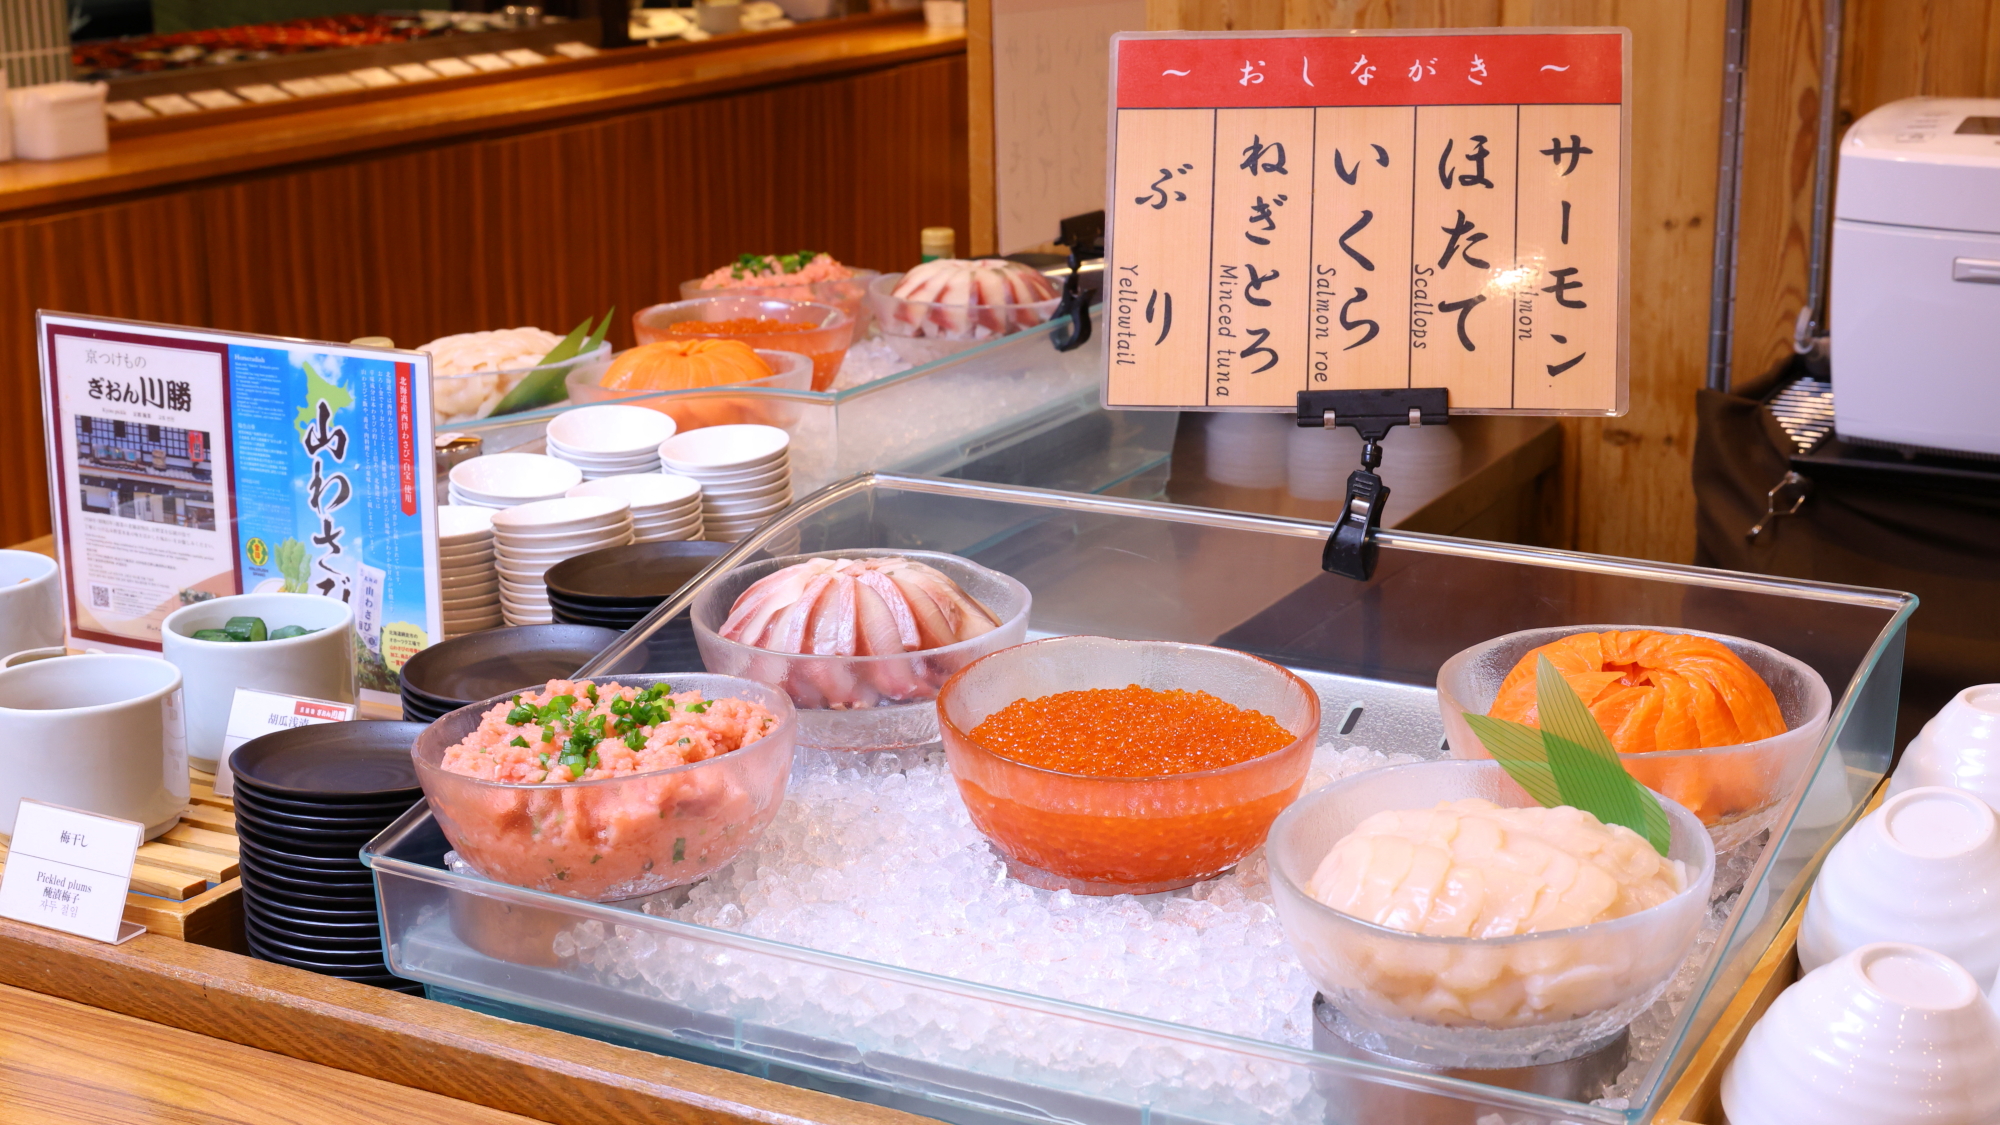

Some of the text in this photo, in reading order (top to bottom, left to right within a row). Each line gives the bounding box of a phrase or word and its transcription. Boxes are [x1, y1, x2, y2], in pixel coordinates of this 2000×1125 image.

[1135, 163, 1194, 347] ぶり
[1239, 134, 1289, 374] ねぎとろ
[1334, 143, 1390, 351] いくら
[1438, 135, 1494, 351] ほたて
[1540, 134, 1593, 377] サーモン
[1116, 264, 1138, 366] Yellowtail
[1216, 264, 1238, 397] Minced tuna
[1314, 264, 1336, 382] Salmon roe
[1411, 264, 1434, 349] Scallops
[1518, 264, 1539, 341] lmon
[85, 349, 146, 369] 京つけもの
[88, 376, 192, 413] ぎおん川勝
[36, 871, 92, 893] Pickled plums
[60, 830, 88, 848] 梅干し
[39, 899, 79, 918] 자두 절임
